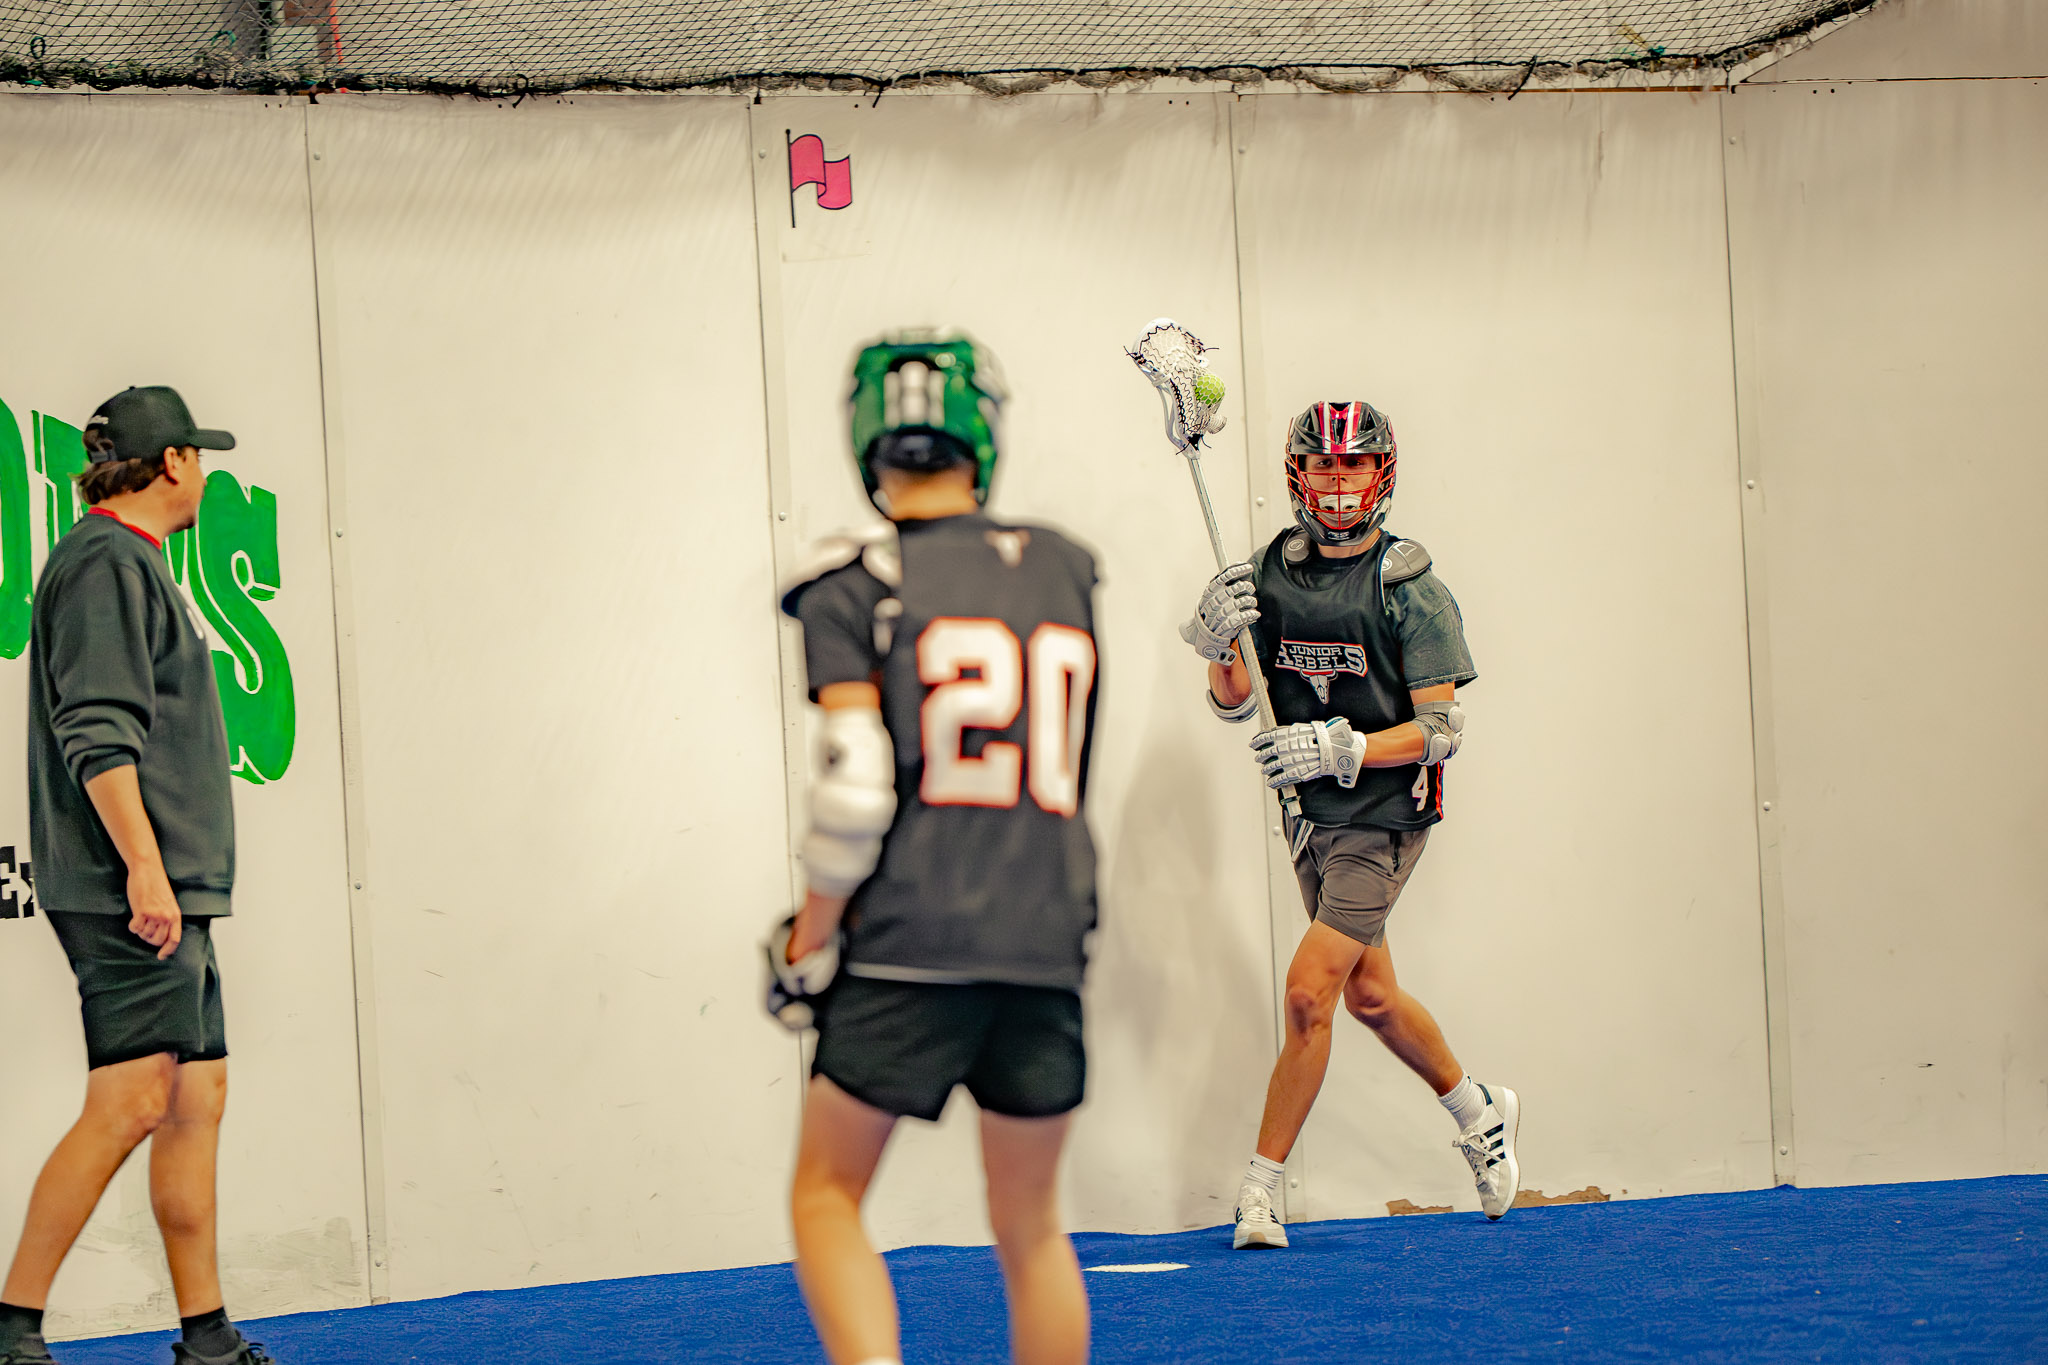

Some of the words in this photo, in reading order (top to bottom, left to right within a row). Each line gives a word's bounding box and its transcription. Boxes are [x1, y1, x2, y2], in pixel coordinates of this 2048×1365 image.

[1289, 645, 1343, 656] JUNIOR
[916, 616, 1096, 819] 20
[1411, 765, 1429, 812] 4
